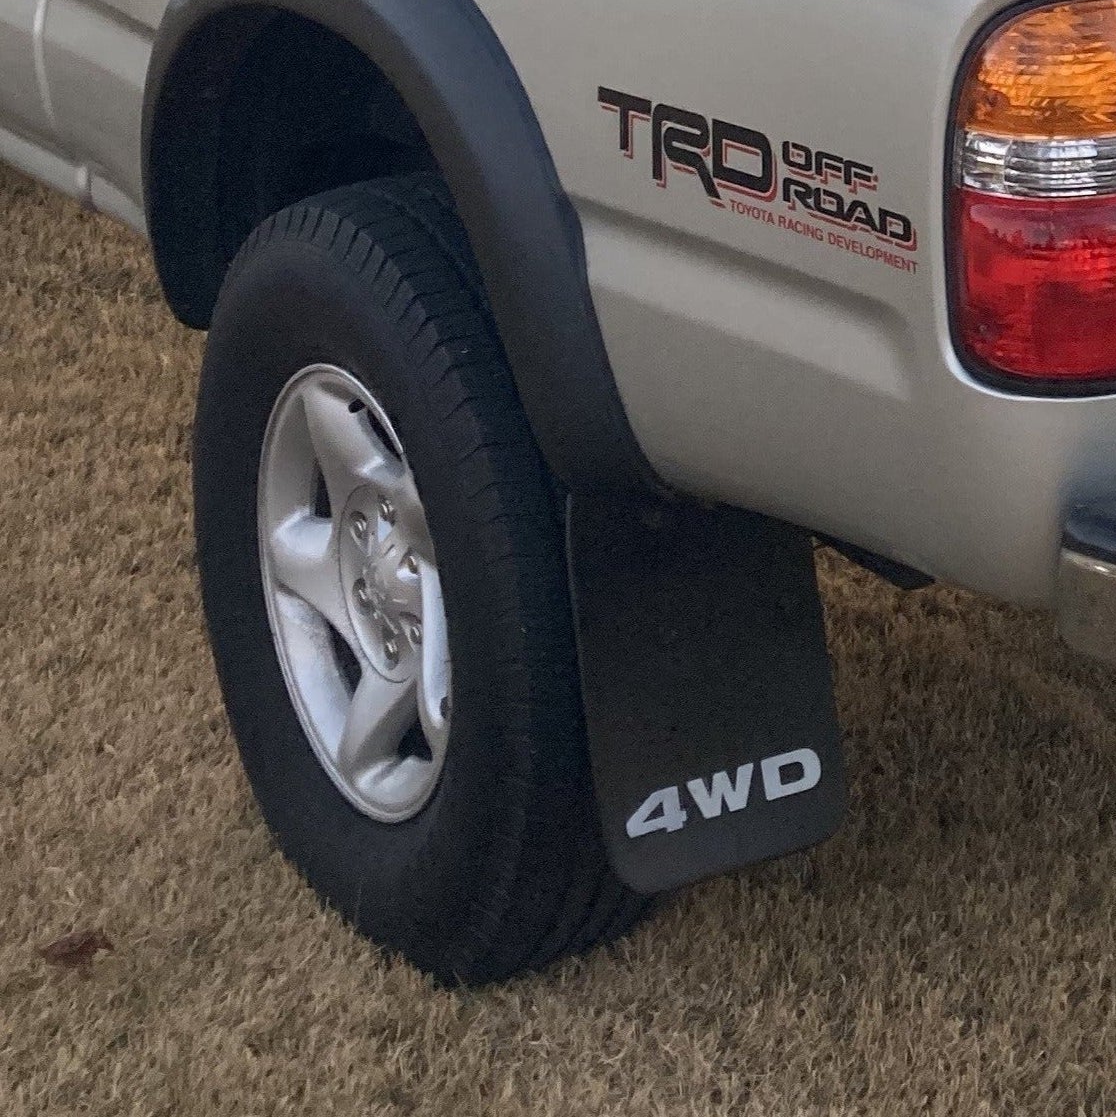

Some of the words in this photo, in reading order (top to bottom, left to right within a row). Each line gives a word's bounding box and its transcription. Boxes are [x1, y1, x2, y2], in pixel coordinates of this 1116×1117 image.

[597, 86, 778, 209] TRD
[782, 140, 878, 194] OFF
[730, 198, 775, 226] TOYOTA
[778, 213, 824, 242] RACING
[828, 231, 919, 275] DEVELOPMENT
[782, 177, 918, 251] ROAD
[626, 747, 822, 838] 4WD
